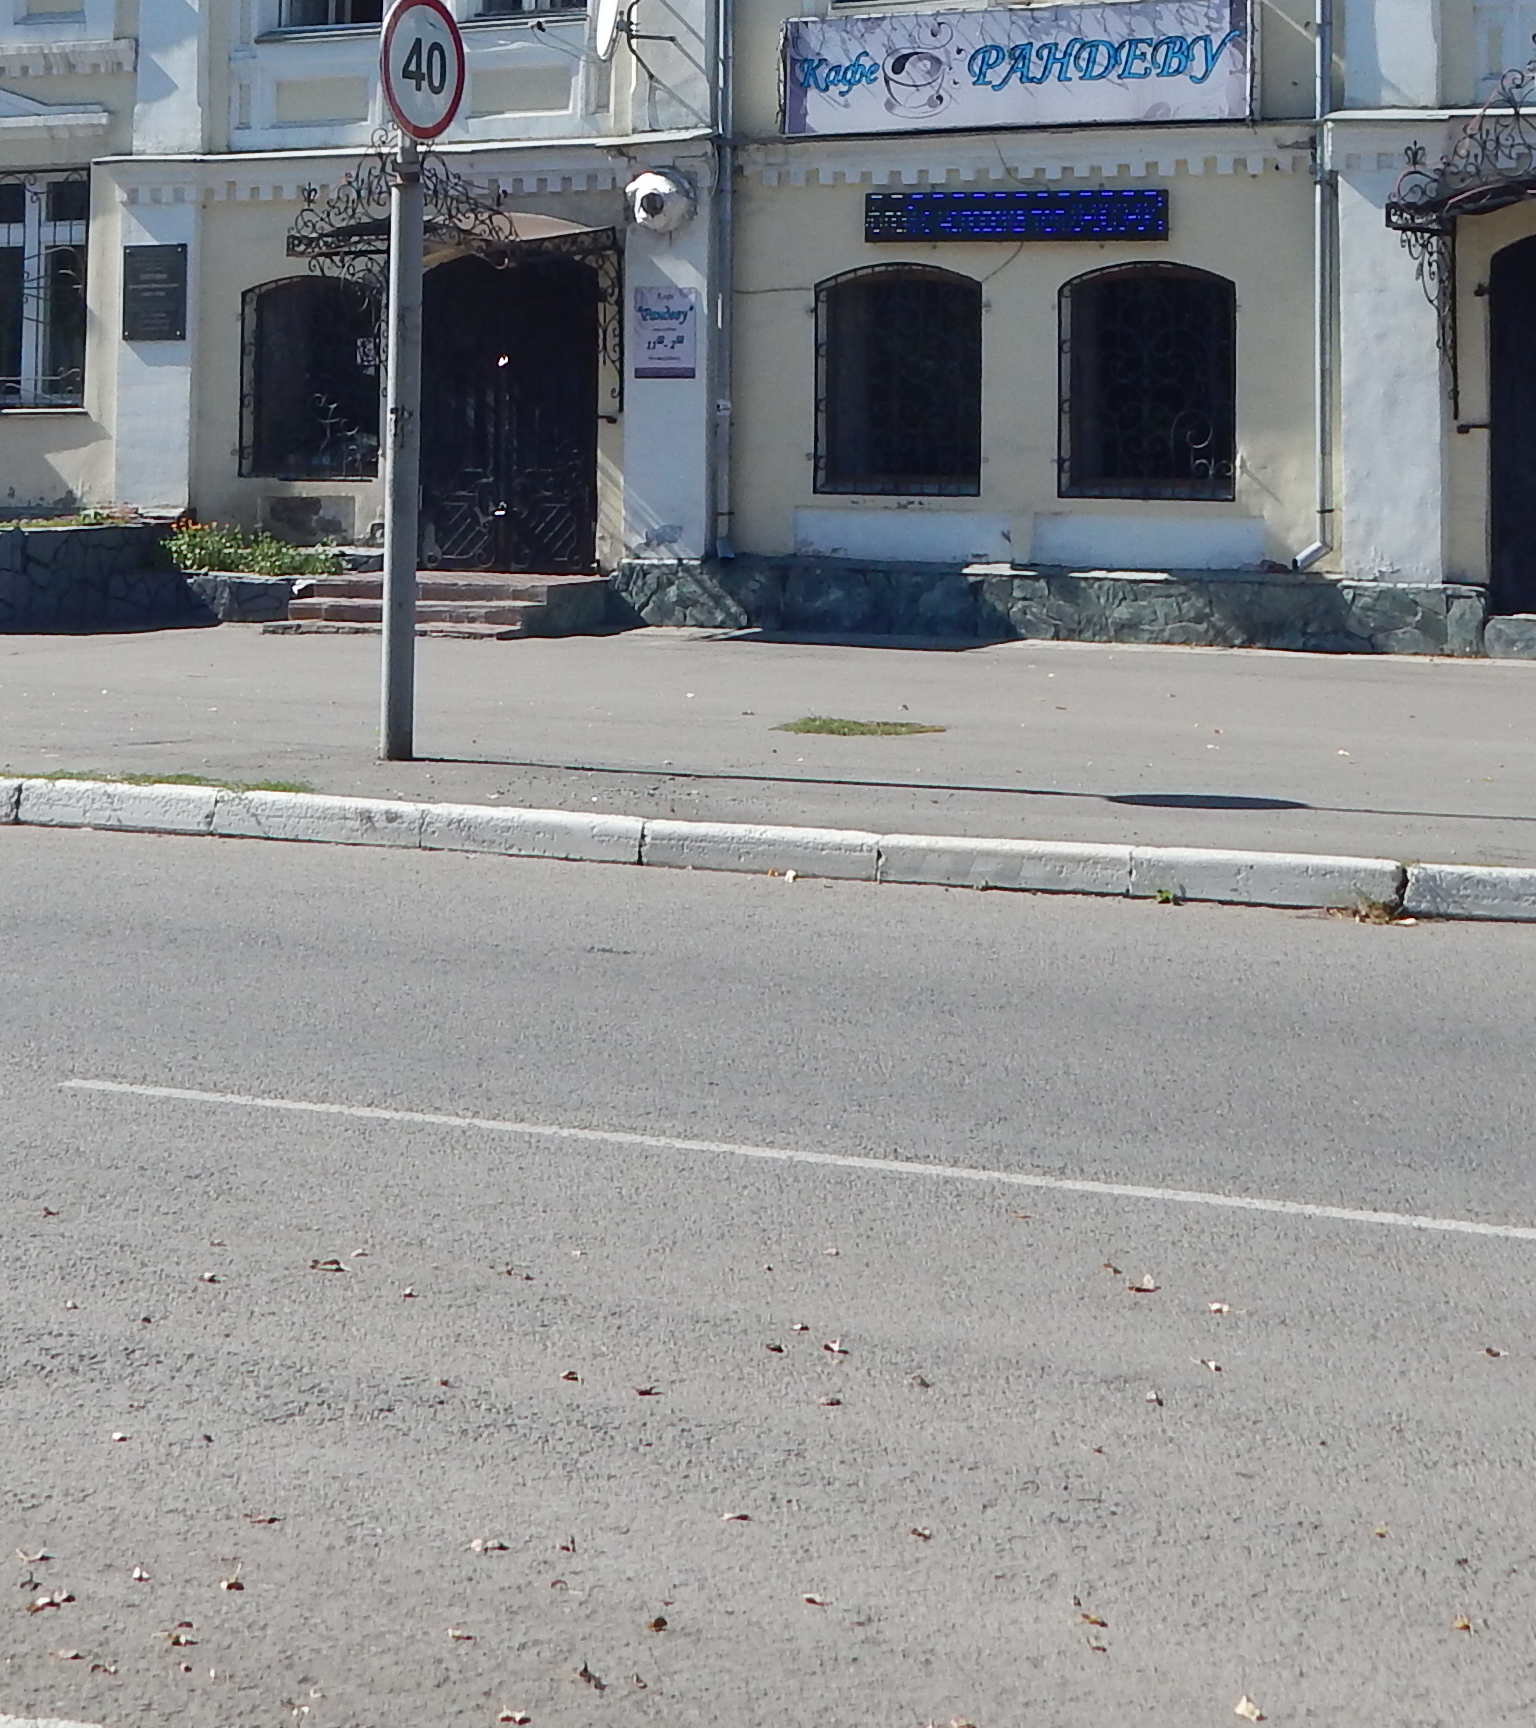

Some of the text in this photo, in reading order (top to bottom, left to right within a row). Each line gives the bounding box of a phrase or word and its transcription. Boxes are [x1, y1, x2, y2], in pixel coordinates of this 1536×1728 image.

[402, 37, 446, 94] 40
[799, 30, 1240, 97] Кафе РАНДЕВУ
